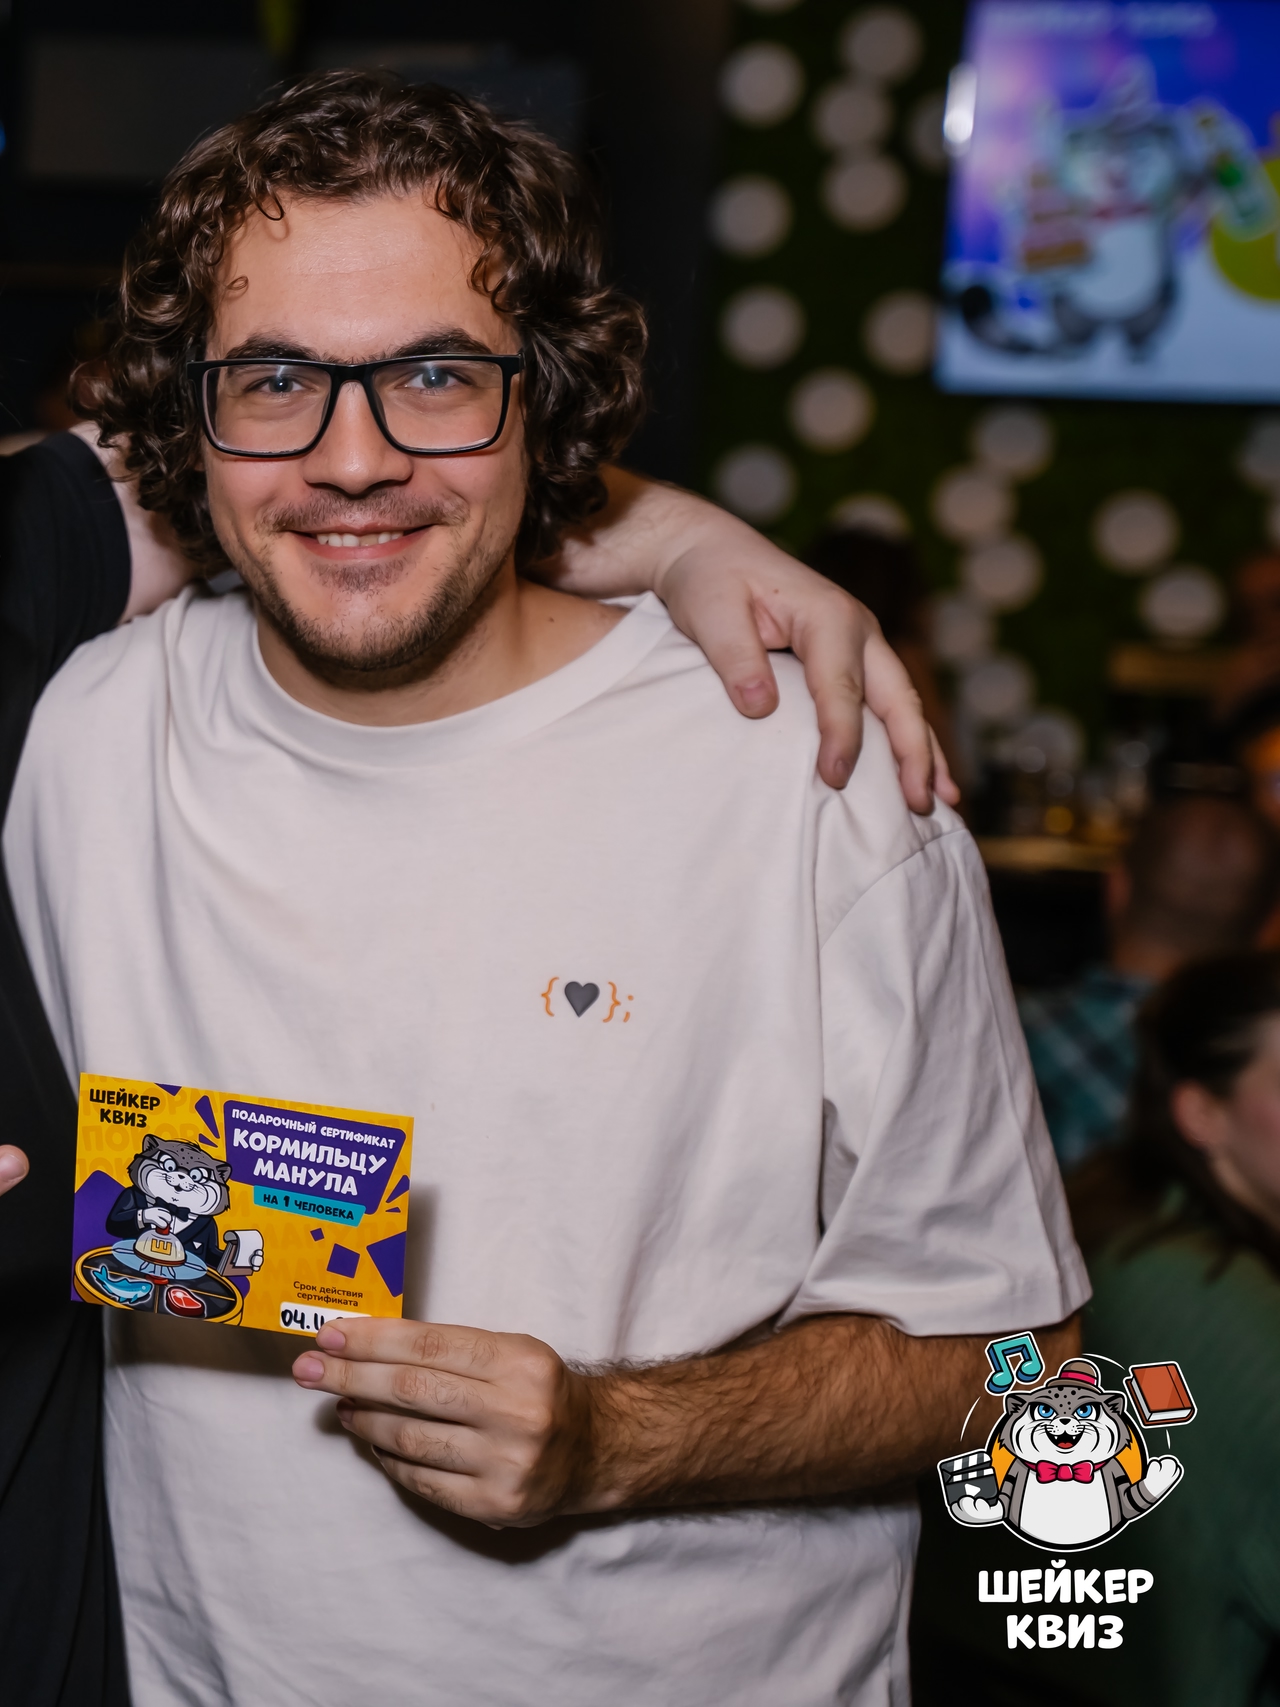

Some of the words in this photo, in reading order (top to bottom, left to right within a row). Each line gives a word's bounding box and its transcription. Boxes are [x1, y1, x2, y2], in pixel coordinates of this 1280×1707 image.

[89, 1088, 161, 1111] ШЕЙКЕР
[99, 1108, 148, 1128] КВИЗ
[231, 1108, 317, 1134] ПОДАРОЧНЫЙ
[320, 1126, 396, 1149] СЕРТИФИКАТ
[232, 1127, 388, 1176] КОРМИЛЬЦУ
[253, 1157, 359, 1196] МАНУЛА
[263, 1193, 279, 1206] НА
[283, 1195, 291, 1208] 1
[294, 1200, 355, 1221] ЧЕЛОВЕКА
[293, 1280, 317, 1292] Срок
[319, 1286, 364, 1299] действия
[297, 1291, 359, 1307] сертификата
